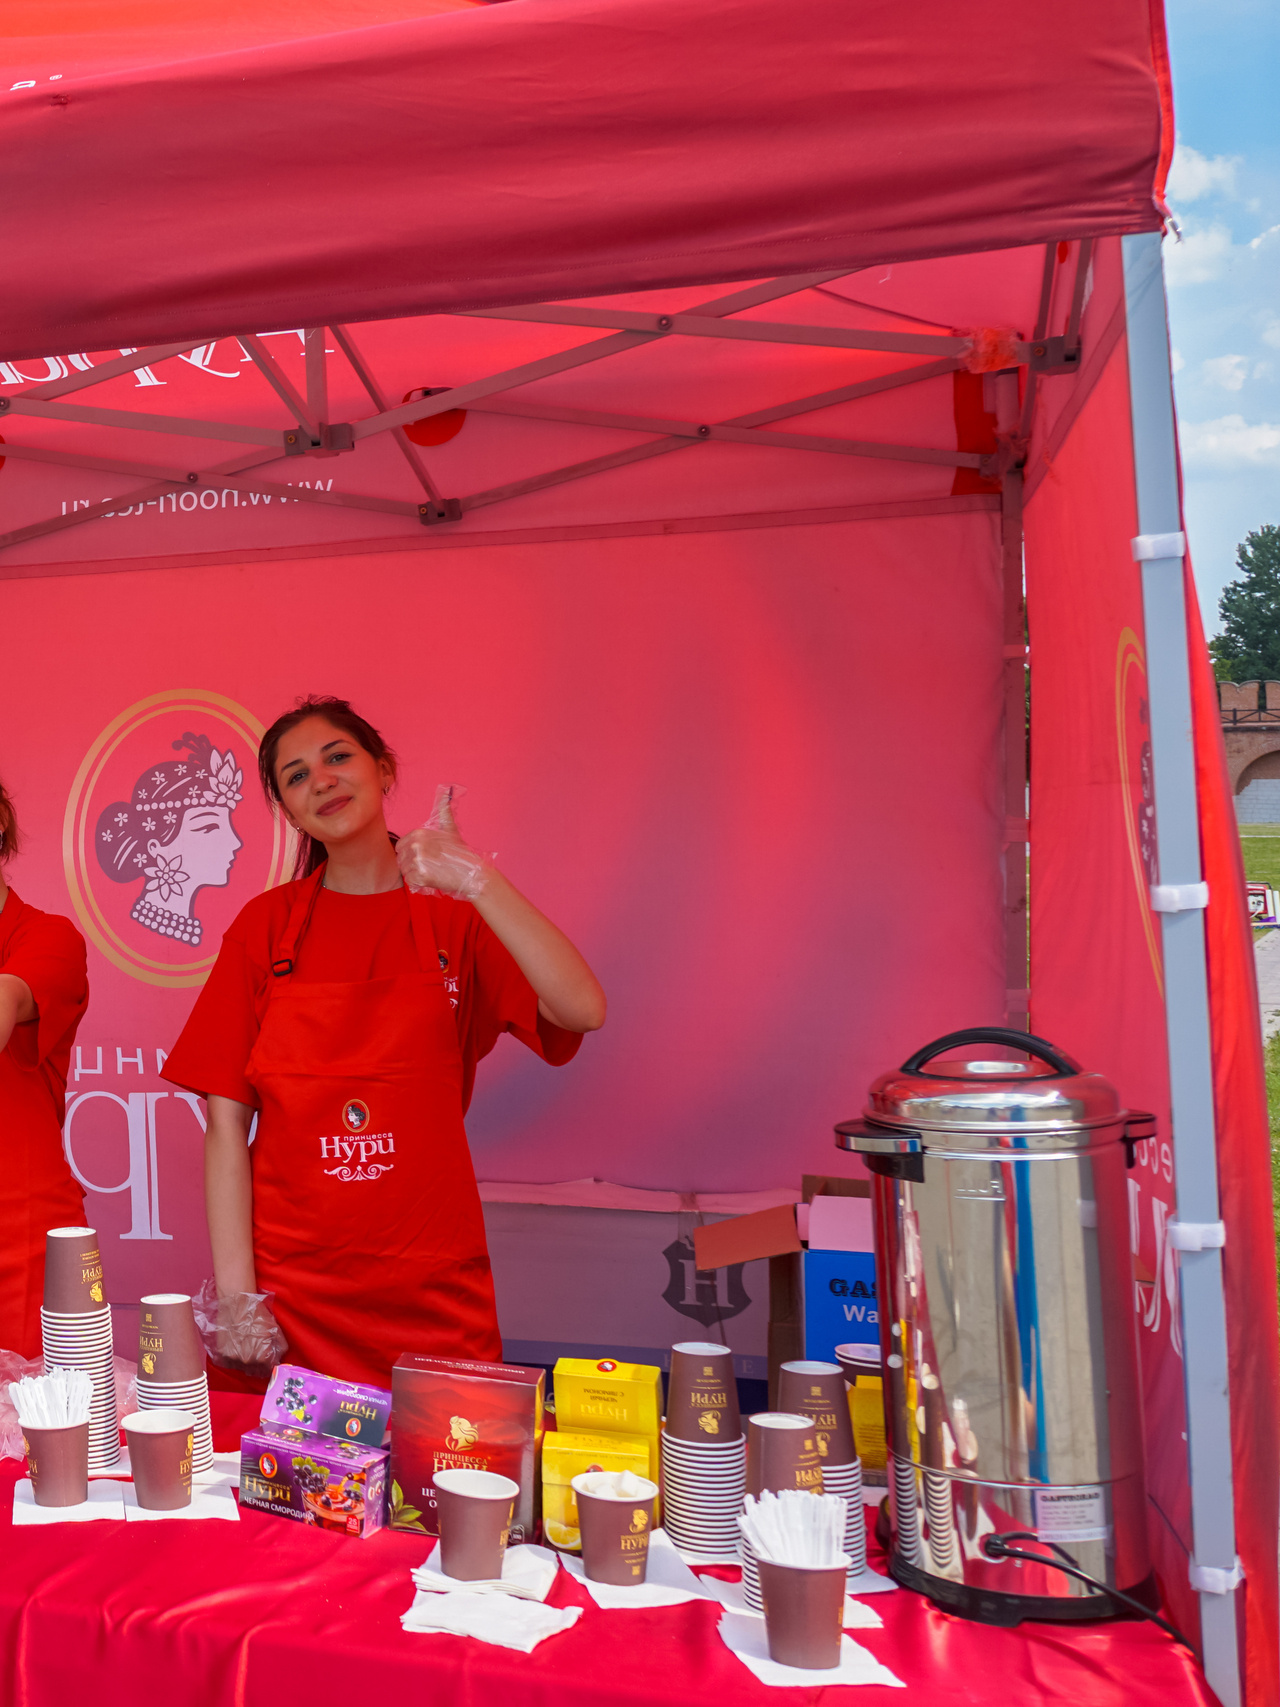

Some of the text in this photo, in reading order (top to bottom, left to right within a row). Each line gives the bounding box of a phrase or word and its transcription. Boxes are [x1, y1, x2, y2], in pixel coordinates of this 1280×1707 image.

[343, 1132, 393, 1142] принцесса
[319, 1135, 396, 1164] Нури
[842, 1304, 879, 1324] Wa
[690, 1391, 727, 1405] НУРИ
[339, 1400, 378, 1421] Нури
[433, 1451, 488, 1466] ПРИНЦЕССА
[245, 1474, 292, 1502] Нури
[244, 1496, 316, 1523] ЧЕРНАЯ СМОРОДИНА
[348, 1518, 358, 1526] 25
